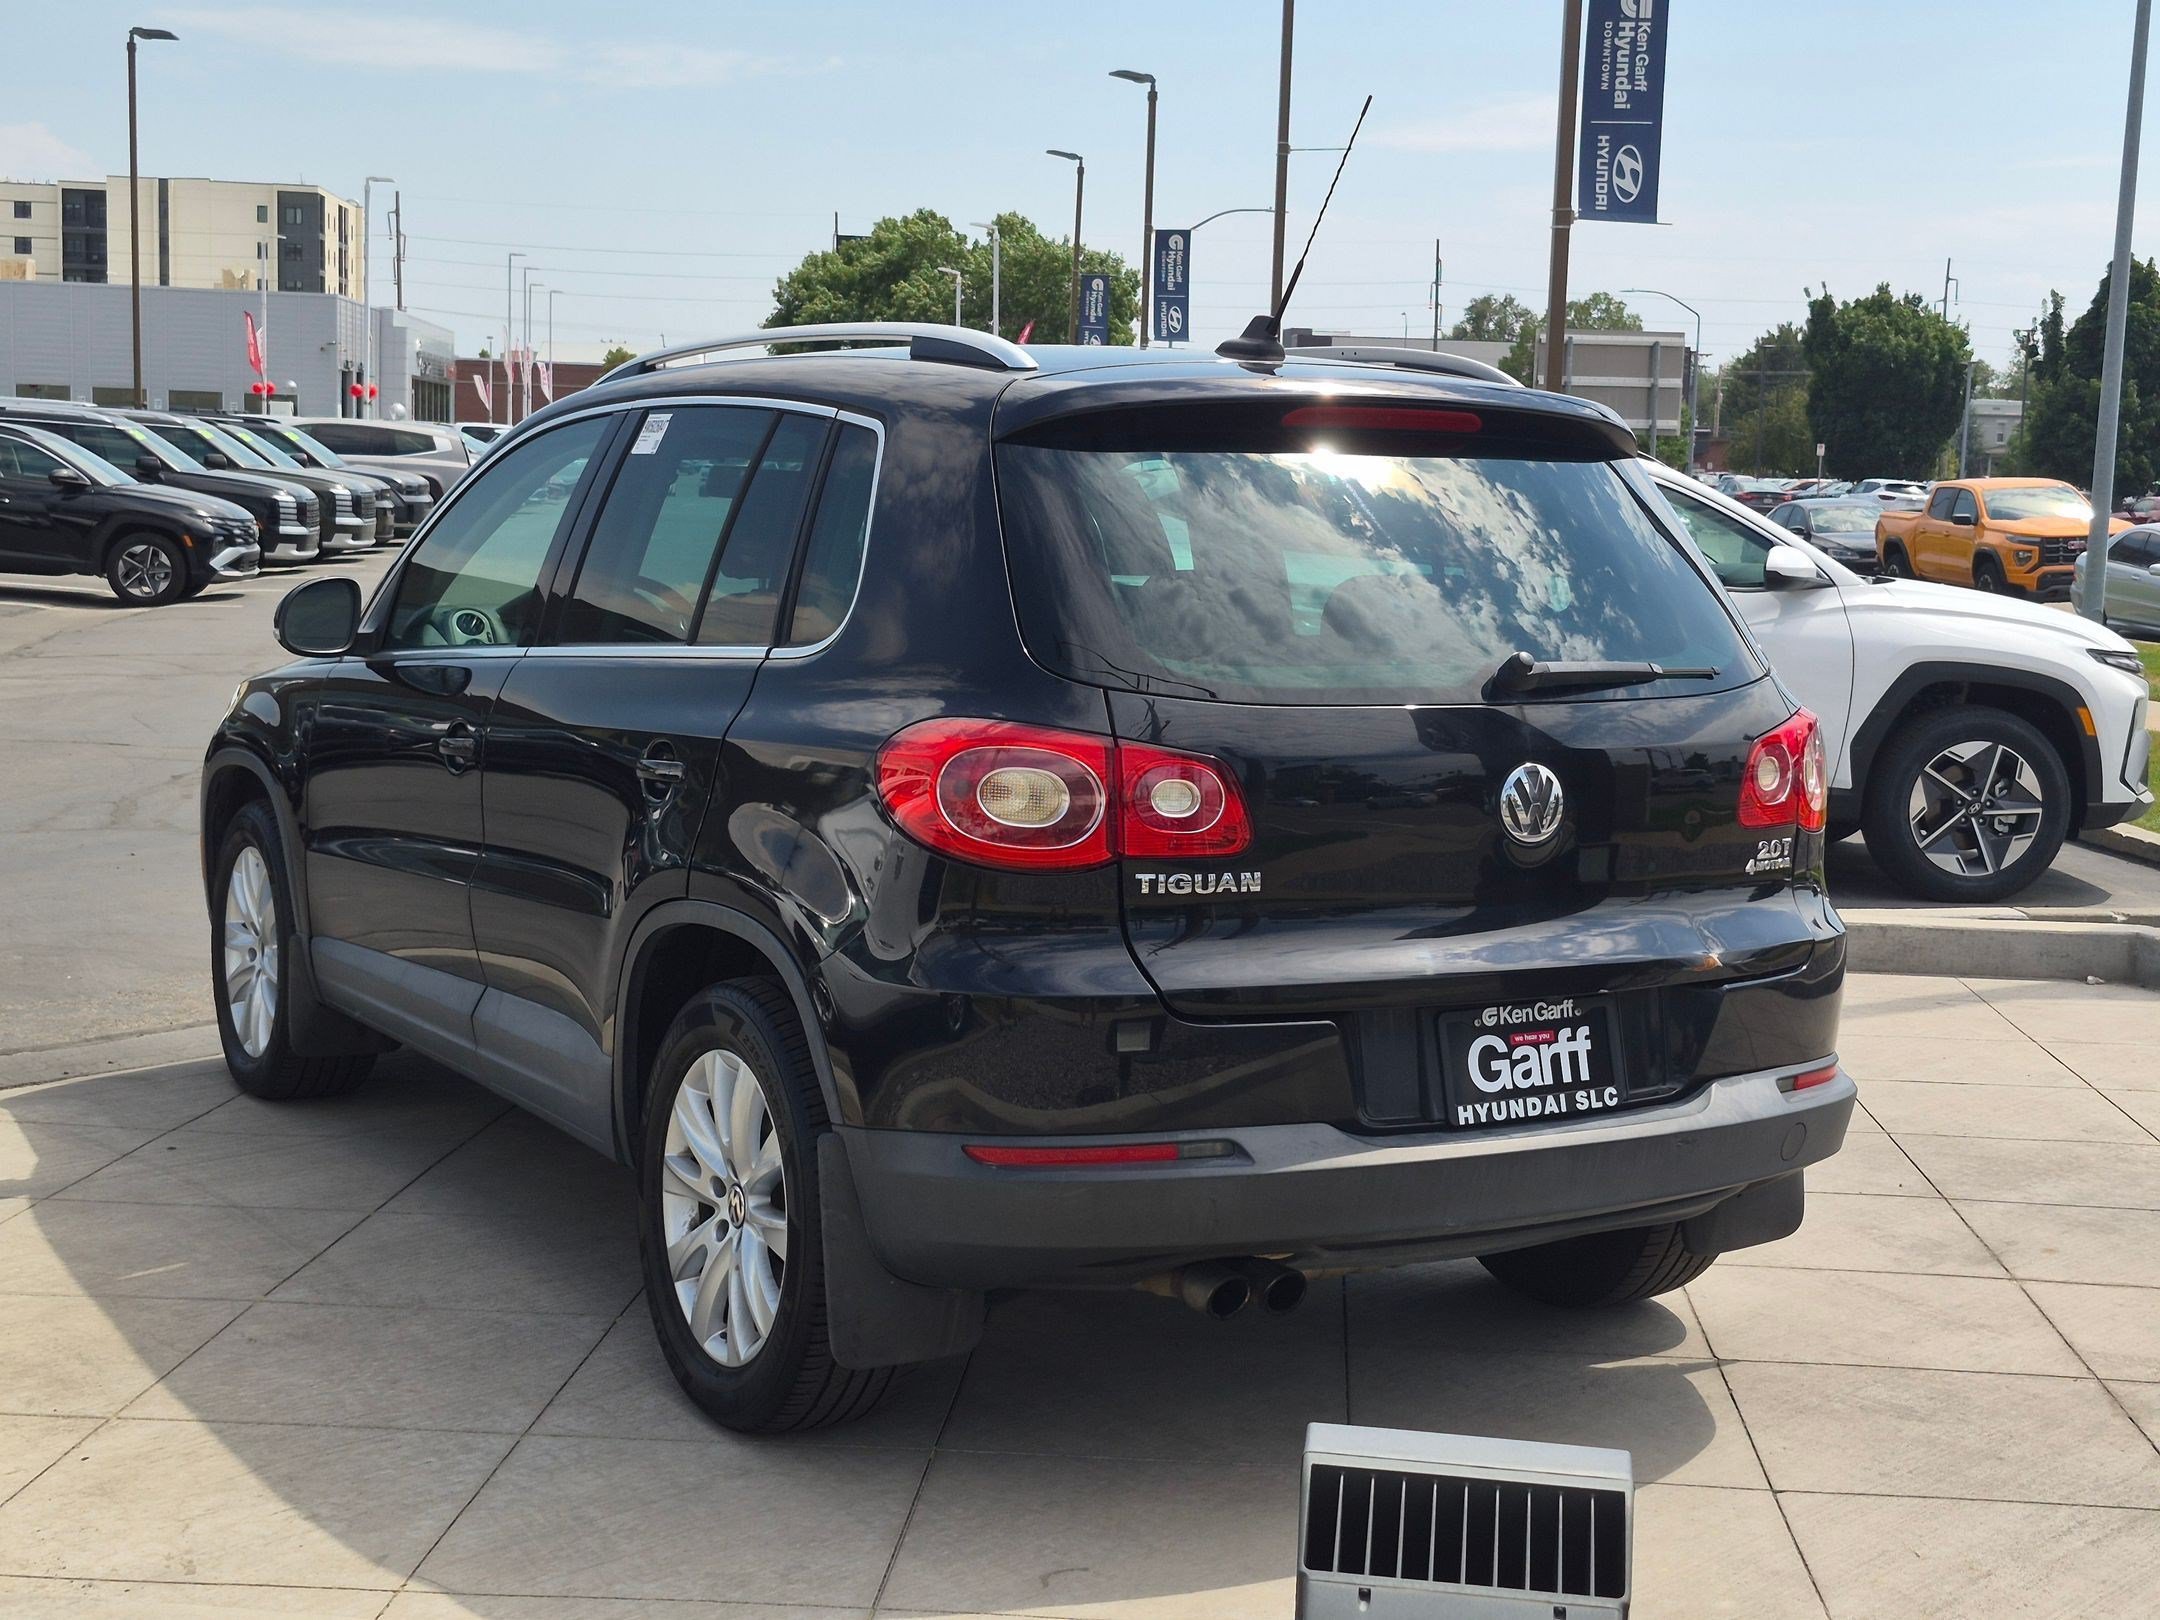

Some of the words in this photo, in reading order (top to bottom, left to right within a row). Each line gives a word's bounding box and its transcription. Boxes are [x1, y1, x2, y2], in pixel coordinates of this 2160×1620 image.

[1601, 22, 1612, 90] DOWNTOWN
[1614, 21, 1636, 110] Hyundai
[1595, 135, 1610, 211] HYUNDAI
[1167, 251, 1175, 290] Hyundai
[1135, 871, 1262, 895] TIGUAN
[1467, 1025, 1592, 1093] Garff
[1539, 1033, 1550, 1041] you
[1457, 1093, 1567, 1125] HYUNDAI
[1575, 1087, 1618, 1111] SLC
